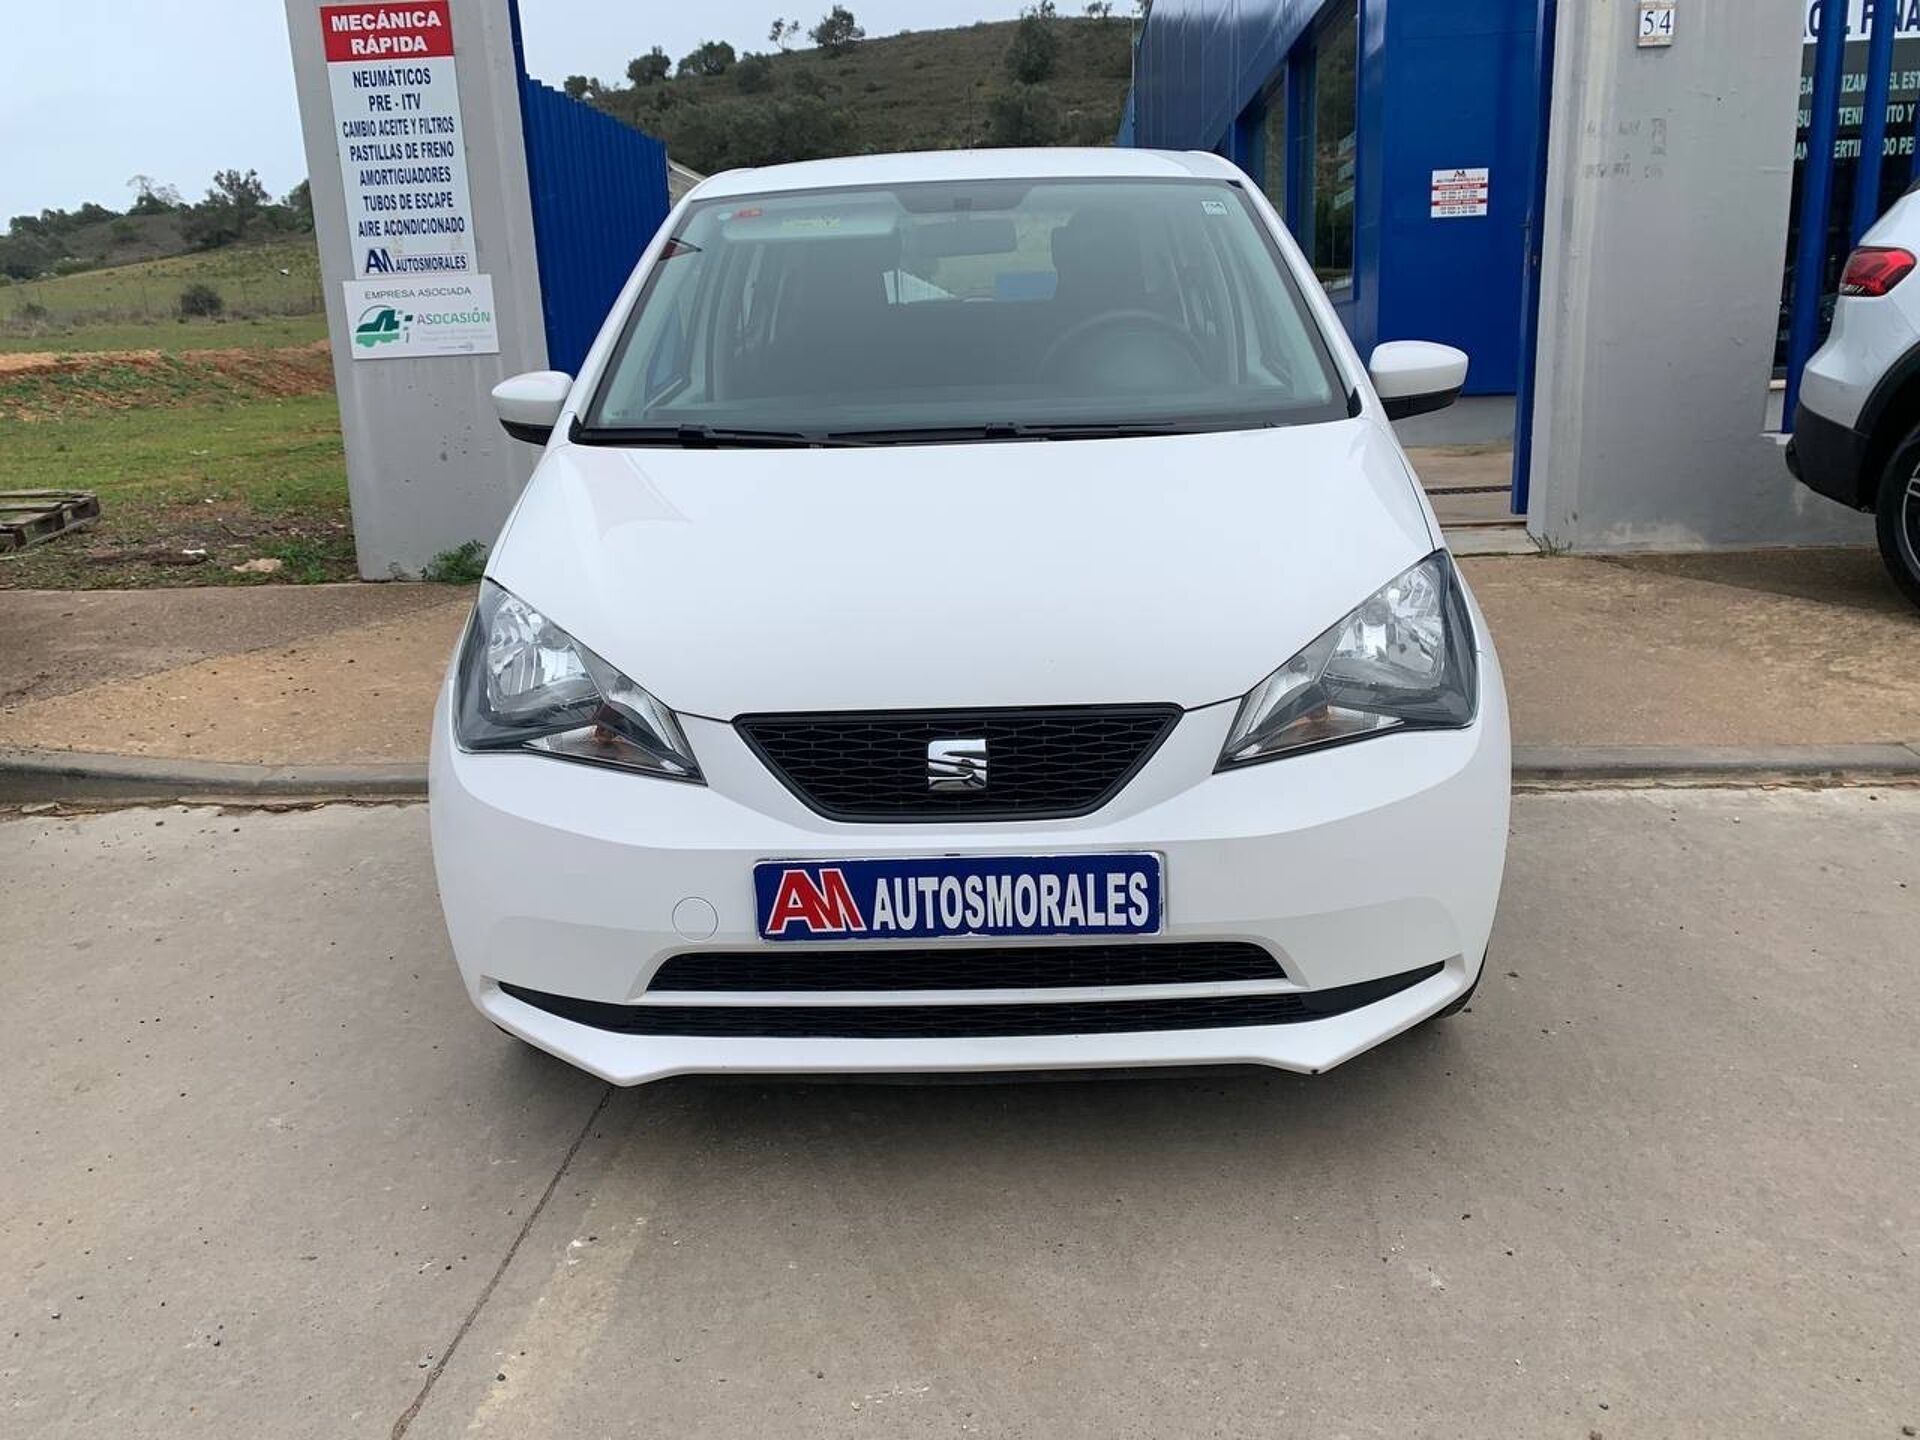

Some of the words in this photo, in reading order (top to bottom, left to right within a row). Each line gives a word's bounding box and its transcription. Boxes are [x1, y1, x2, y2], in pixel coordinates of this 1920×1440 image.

[331, 9, 442, 33] MECÁNICA
[1643, 10, 1671, 35] 54
[351, 34, 428, 55] RÁPIDA
[353, 65, 432, 88] NEUMÁTICOS
[368, 95, 392, 112] PRE
[401, 93, 421, 111] ITV
[343, 120, 377, 138] CAMBIO
[378, 118, 409, 136] ACEITE
[410, 117, 418, 134] Y
[419, 116, 455, 135] FILTROS
[350, 143, 403, 162] PASTILLAS
[404, 142, 419, 159] DE
[421, 141, 454, 159] FRENO
[360, 166, 451, 187] AMORTIGUADORES
[363, 194, 397, 211] TUBOS
[399, 193, 413, 210] DE
[415, 191, 454, 209] ESCAPE
[358, 220, 382, 237] AIRE
[383, 216, 466, 236] ACONDICIONADO
[395, 255, 467, 272] AUTOSMORALES
[364, 288, 416, 300] EMPRESA
[417, 286, 472, 298] ASOCIADA
[416, 306, 491, 326] ASOCASIÓN
[872, 871, 1149, 931] AUTOSMORALES
